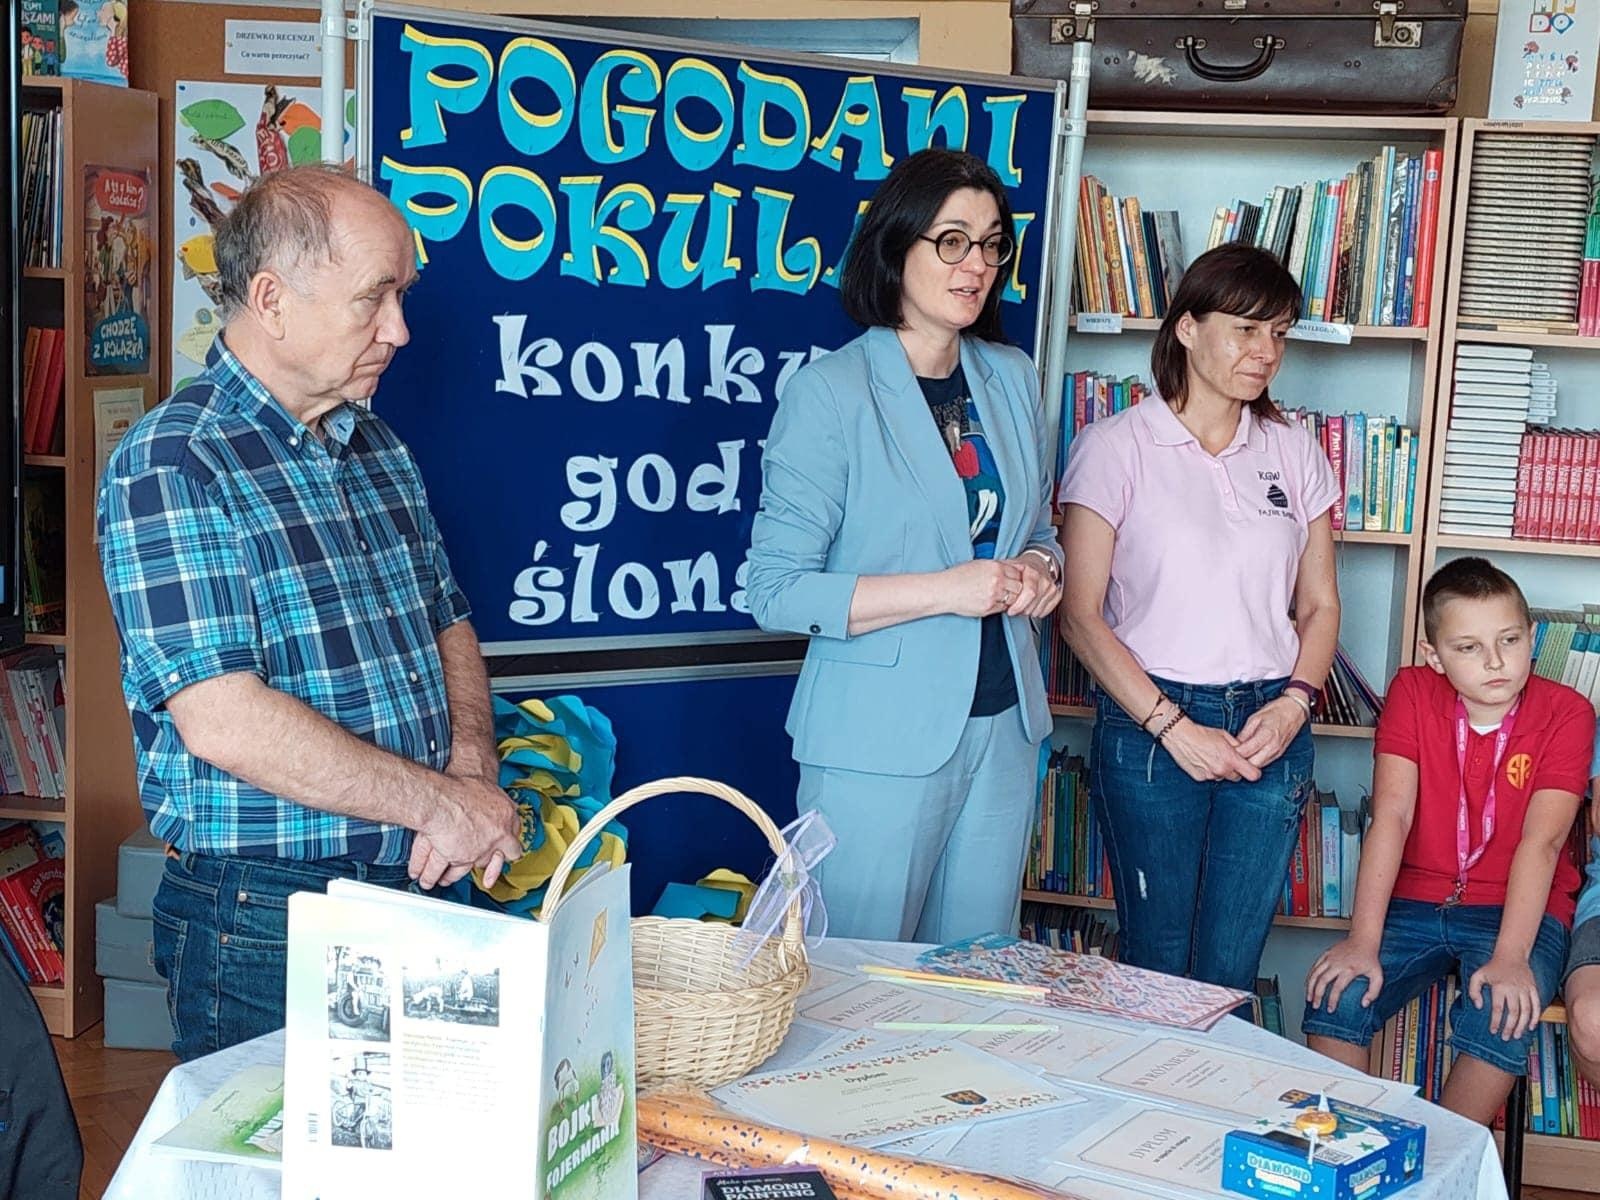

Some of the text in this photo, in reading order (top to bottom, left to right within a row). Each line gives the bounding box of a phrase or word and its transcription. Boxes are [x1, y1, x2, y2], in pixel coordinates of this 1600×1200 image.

[235, 32, 315, 42] DRZEWKO RECENZJI
[240, 50, 250, 58] Co
[271, 52, 310, 61] przeczytać?
[401, 23, 1027, 188] POGODANI
[381, 155, 1036, 303] POKULI
[101, 316, 136, 341] CHODZĘ
[1257, 470, 1281, 481] KGW
[560, 439, 767, 532] god
[721, 1181, 812, 1194] DIAMOND
[725, 1189, 816, 1200] PAINTING
